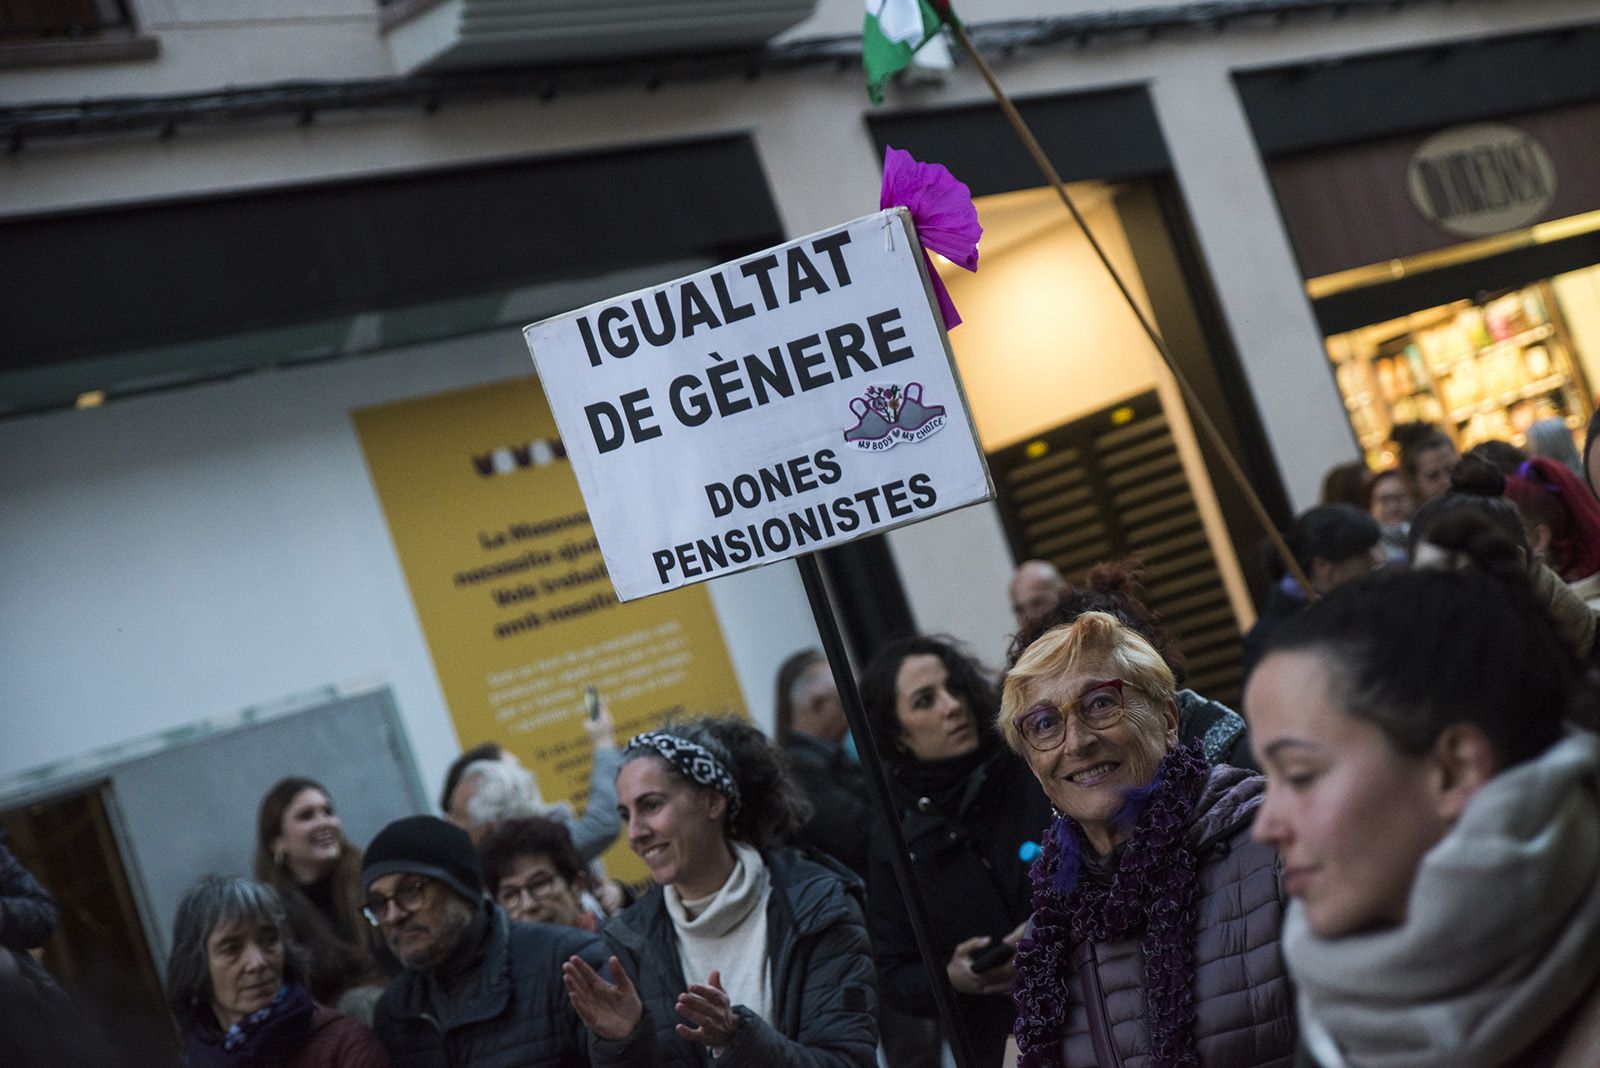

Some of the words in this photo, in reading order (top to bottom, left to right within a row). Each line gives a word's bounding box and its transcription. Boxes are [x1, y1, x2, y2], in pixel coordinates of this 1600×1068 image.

[575, 229, 853, 368] IGUALTAT
[583, 387, 663, 455] DE
[668, 307, 915, 428] GÈNERE
[857, 440, 871, 449] MY
[872, 435, 894, 451] BODY
[901, 431, 915, 442] MY
[916, 417, 944, 440] CHOICE
[652, 473, 937, 585] PENSIONISTES
[704, 448, 843, 519] DONES
